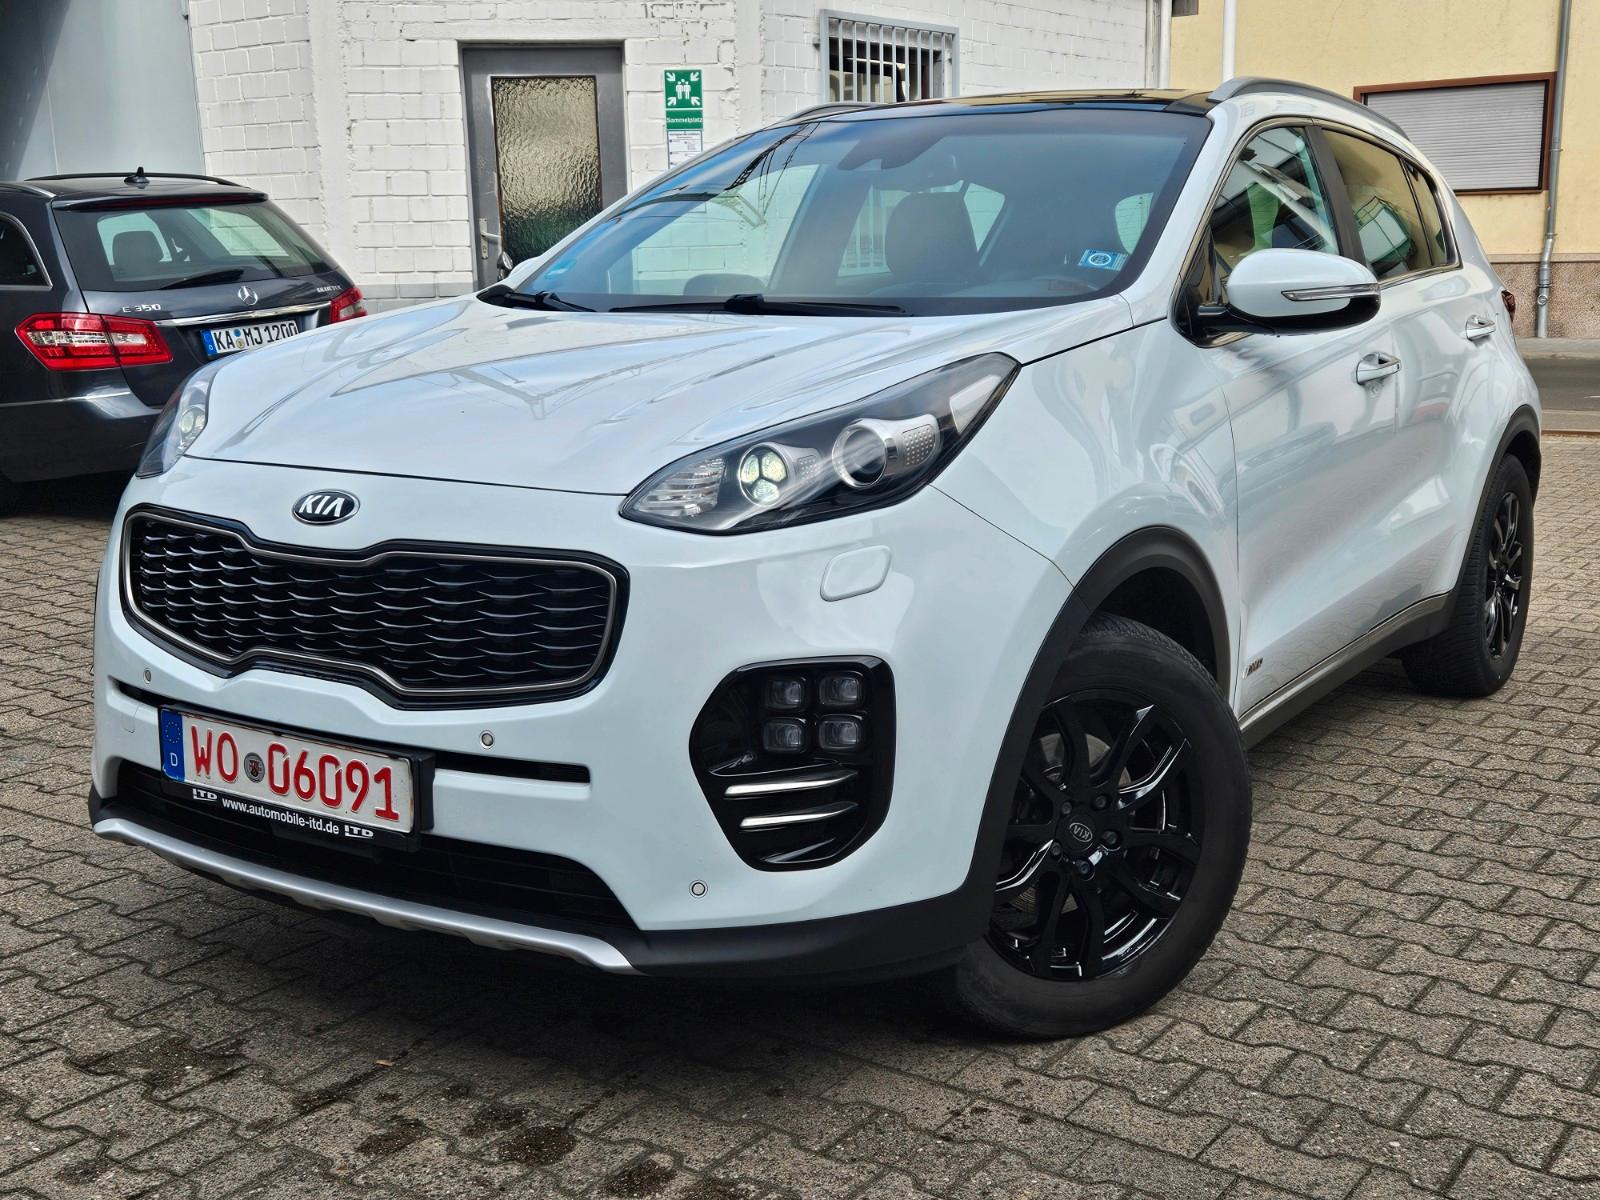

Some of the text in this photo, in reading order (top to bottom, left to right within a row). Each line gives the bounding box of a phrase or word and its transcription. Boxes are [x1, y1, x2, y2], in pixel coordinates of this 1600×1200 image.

[134, 303, 161, 312] 350
[213, 322, 297, 350] KA MJ 1200
[299, 495, 345, 517] KIA
[170, 752, 178, 767] D
[191, 724, 400, 822] WO 06091
[221, 798, 340, 835] www.automobile-itd.de
